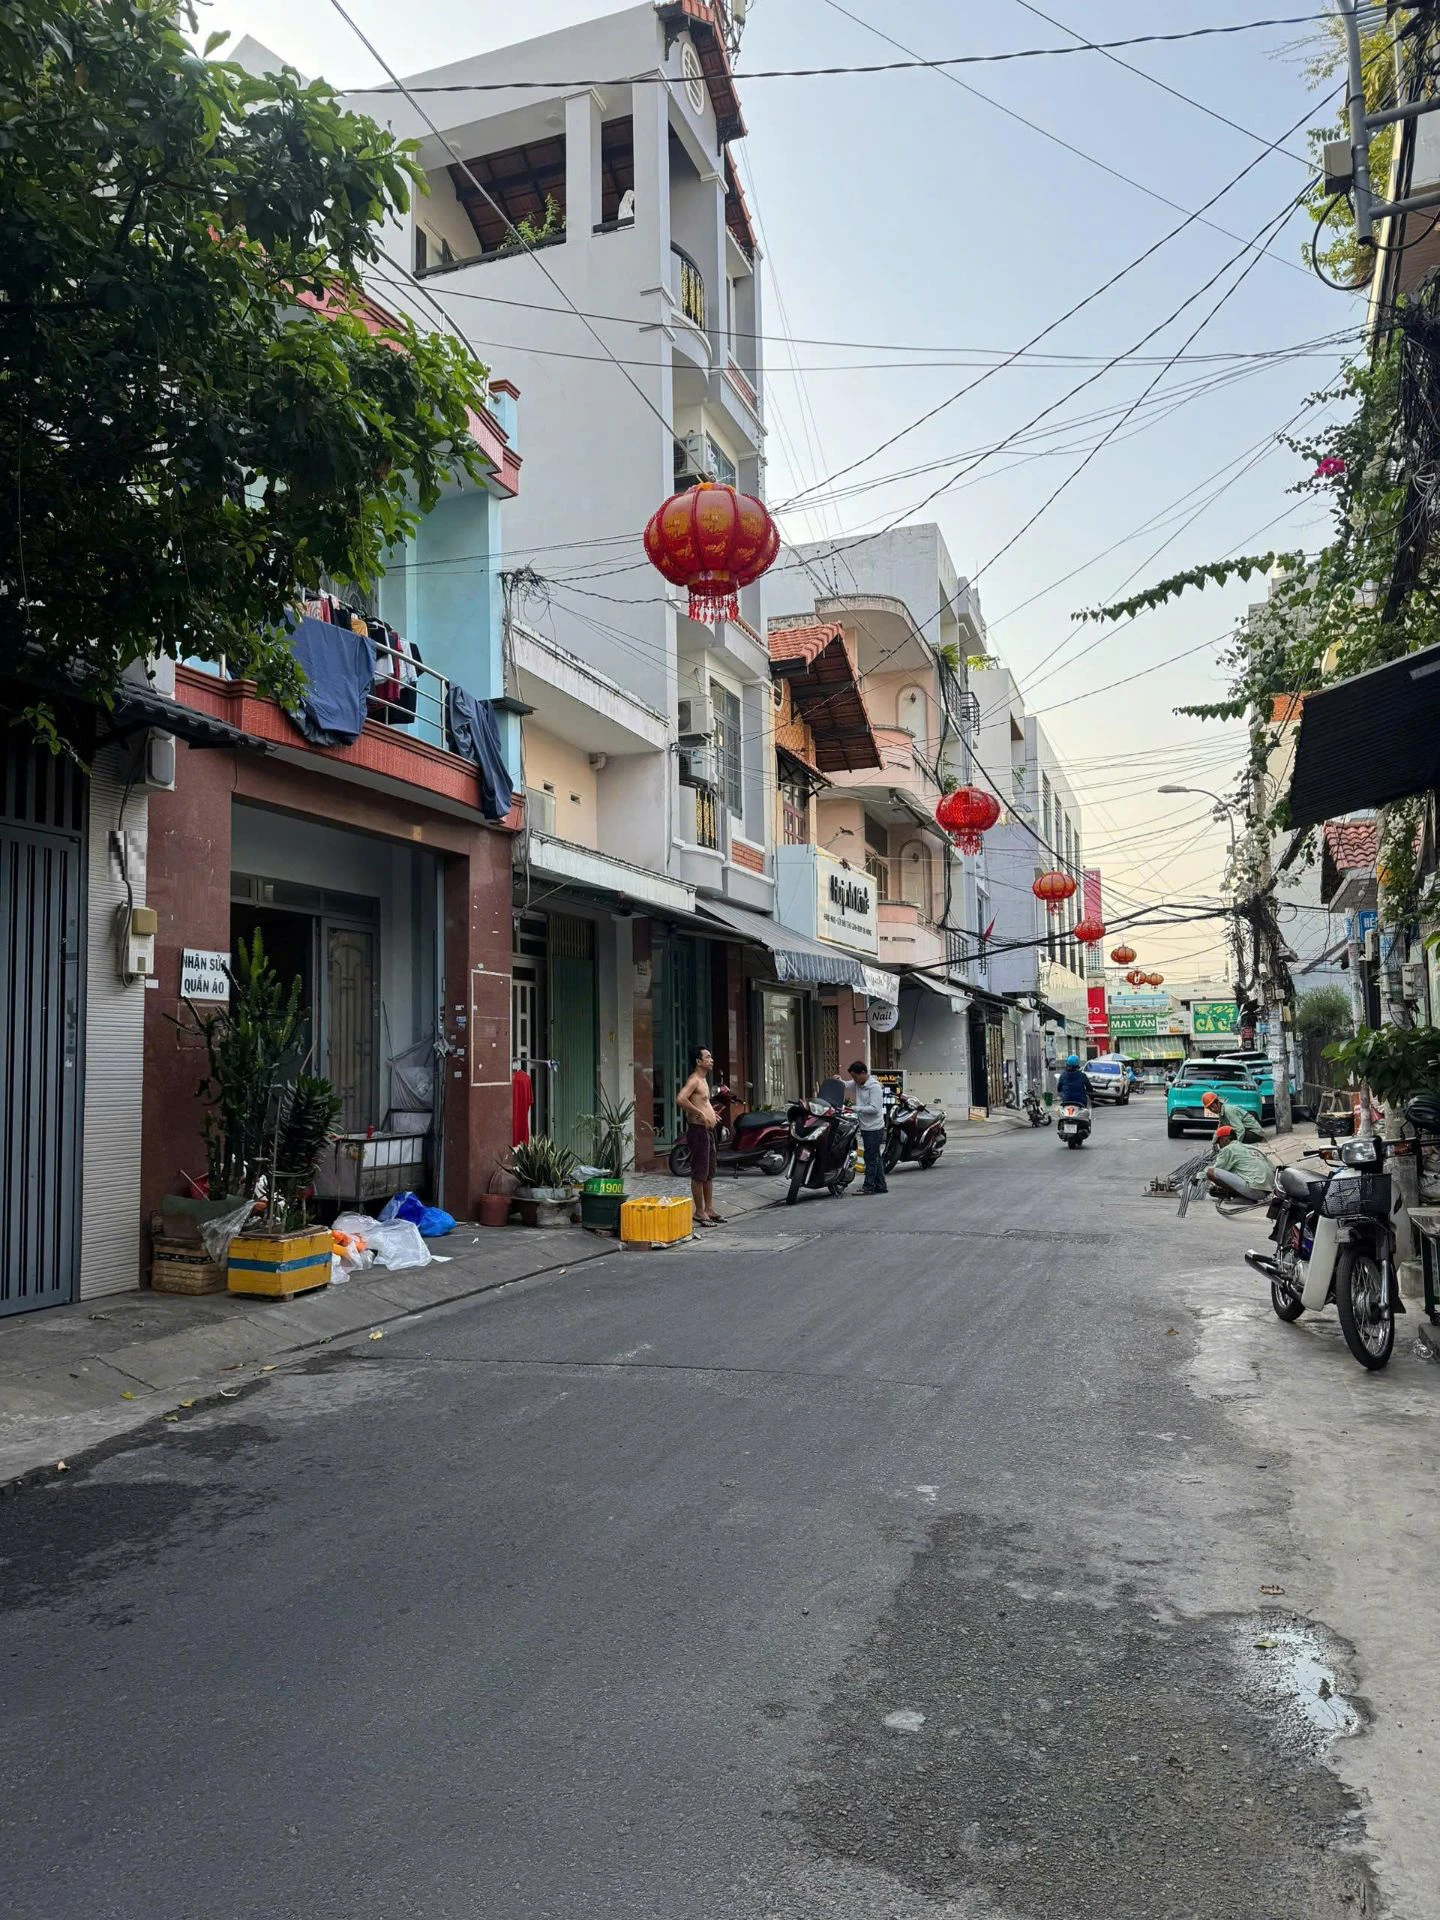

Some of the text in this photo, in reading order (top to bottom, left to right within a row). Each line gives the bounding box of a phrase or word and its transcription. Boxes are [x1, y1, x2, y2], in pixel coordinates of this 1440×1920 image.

[184, 953, 207, 972] NHẬN
[211, 978, 224, 994] ÁO
[872, 1011, 892, 1021] Nail
[1111, 1020, 1131, 1029] MAI
